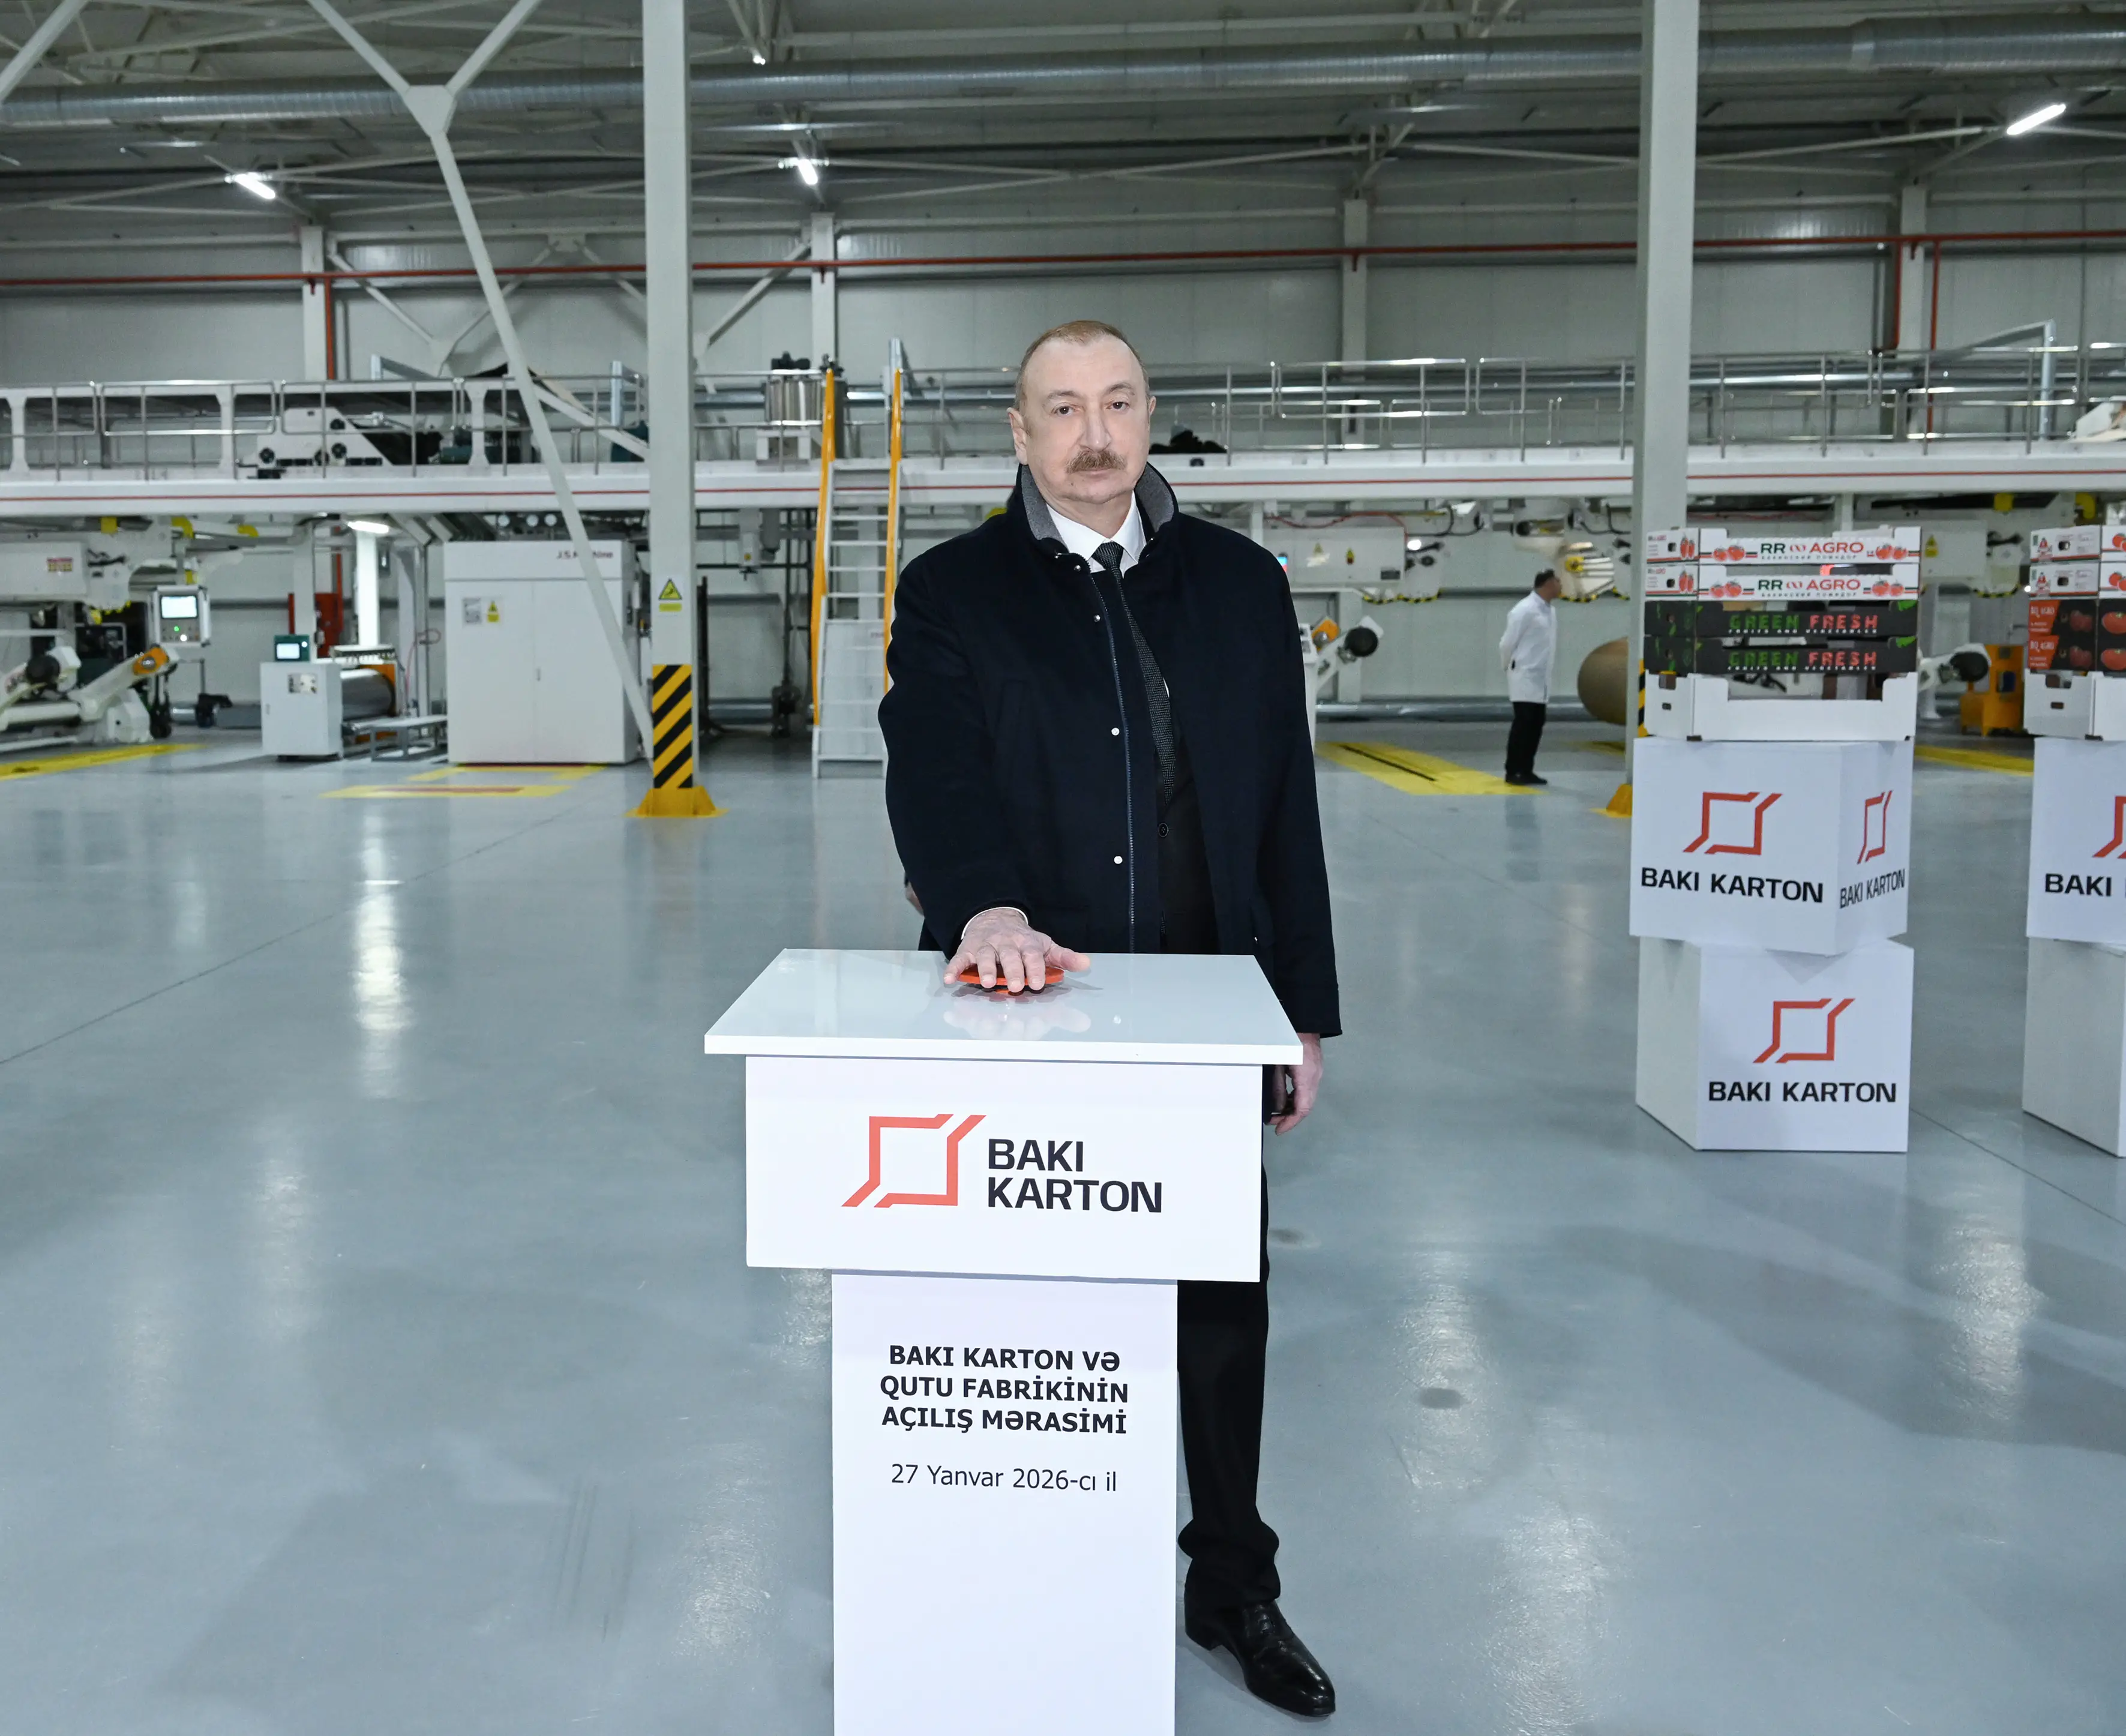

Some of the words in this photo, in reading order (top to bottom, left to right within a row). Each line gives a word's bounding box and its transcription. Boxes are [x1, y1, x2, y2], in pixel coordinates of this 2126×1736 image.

[1760, 542, 1786, 553] RR
[1809, 542, 1864, 553] AGRO
[1758, 579, 1783, 590] RR
[1806, 579, 1861, 590] AGRO
[1729, 614, 1800, 629] GREEN
[1809, 614, 1878, 629] FRESH
[1729, 652, 1799, 666] GREEN
[1809, 652, 1877, 666] FRESH
[1641, 867, 1700, 892] BAKI
[1710, 873, 1823, 903] KARTON
[1840, 882, 1863, 909] BAKI
[1866, 868, 1905, 900] KARTON
[2045, 873, 2112, 897] BAKI
[1708, 1081, 1771, 1102] BAKI
[1783, 1082, 1897, 1102] KARTON
[988, 1138, 1084, 1172] BAKI
[988, 1177, 1162, 1213] KARTON
[889, 1345, 954, 1366] BAKI
[963, 1347, 1074, 1371] KARTON
[1082, 1351, 1120, 1372] VƏ
[880, 1375, 953, 1401] QUTU
[962, 1375, 1128, 1403] FABRİKİNİN
[881, 1406, 973, 1434] AÇILIŞ
[982, 1408, 1127, 1434] MƏRASİMİ
[891, 1464, 918, 1484] 27
[926, 1465, 1004, 1488] Yanvar
[1012, 1468, 1096, 1491] 2026-cı
[1106, 1471, 1116, 1492] il
